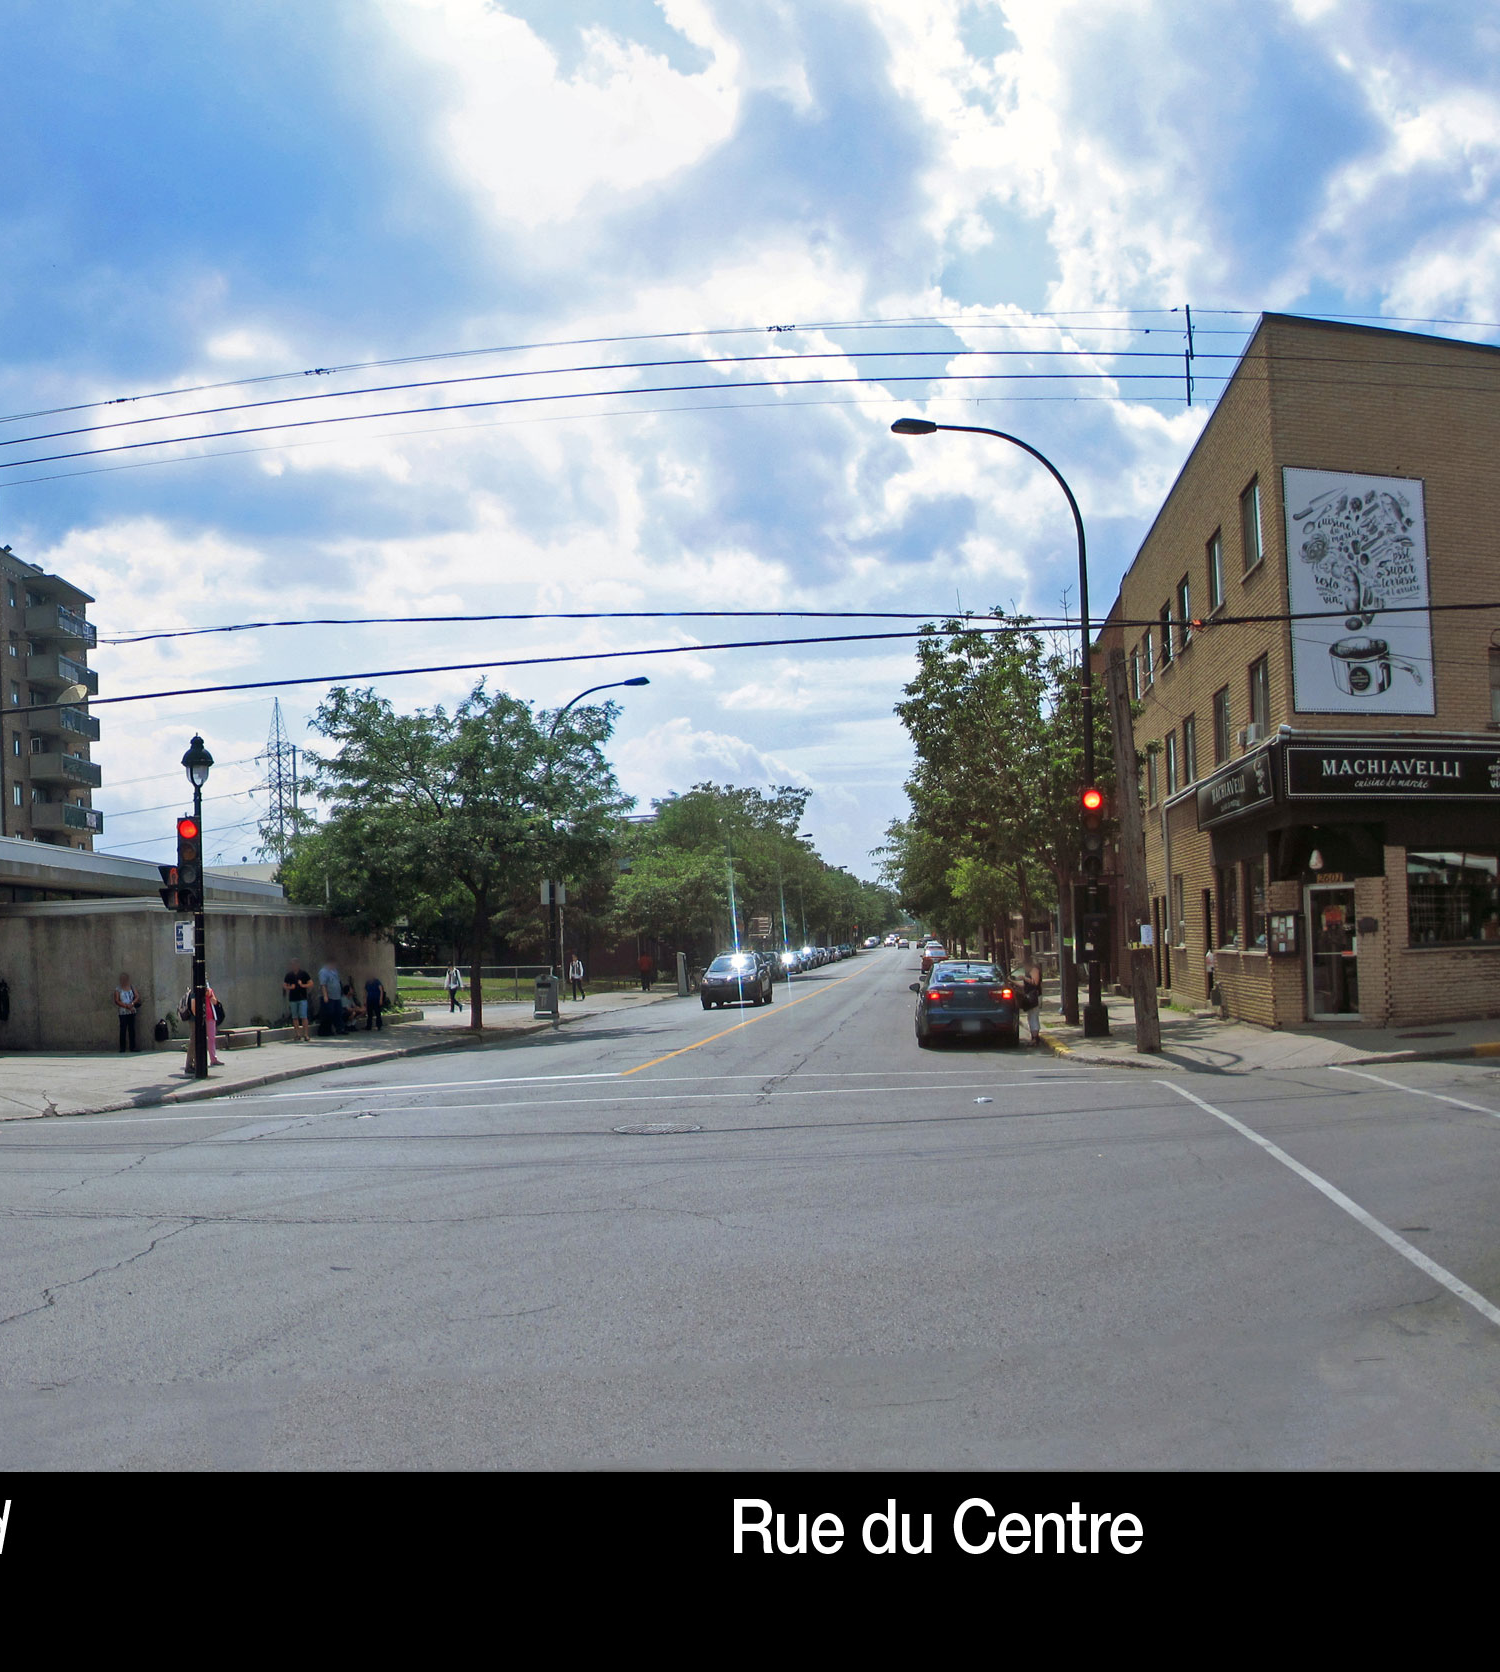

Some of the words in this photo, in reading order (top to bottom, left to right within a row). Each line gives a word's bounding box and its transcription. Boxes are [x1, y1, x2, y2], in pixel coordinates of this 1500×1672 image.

[1384, 564, 1417, 579] super
[1322, 758, 1461, 778] MACHIAVELLI
[1354, 777, 1386, 788] cuisine
